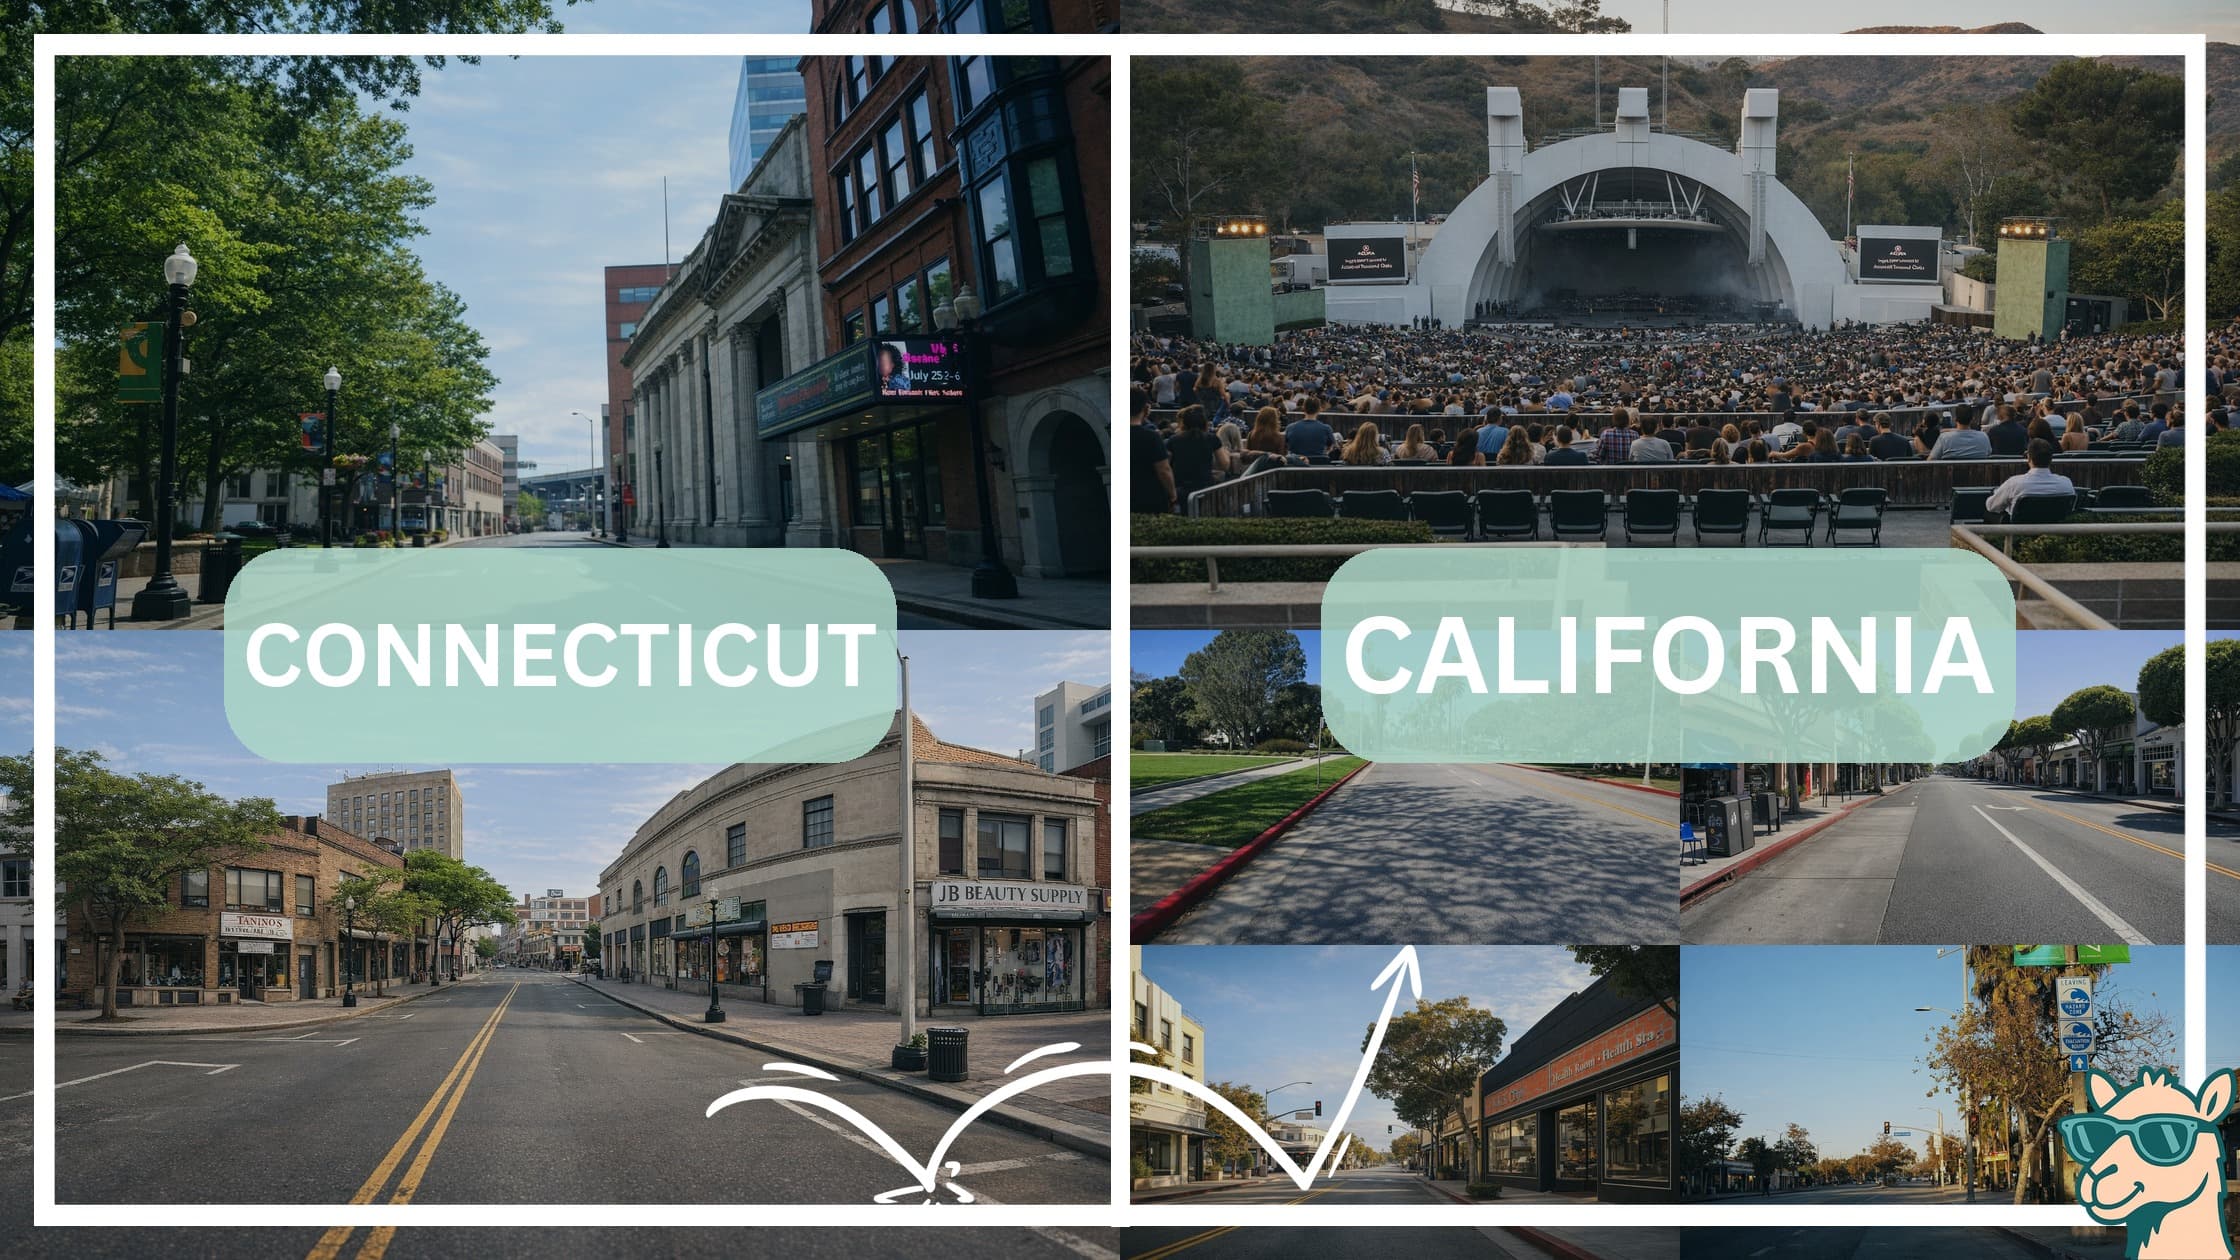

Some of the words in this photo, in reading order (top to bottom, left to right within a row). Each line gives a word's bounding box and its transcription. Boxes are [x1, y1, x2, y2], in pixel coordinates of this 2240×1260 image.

[911, 369, 929, 383] July
[939, 885, 960, 902] JB
[965, 886, 1028, 902] BEAUTY
[1031, 888, 1084, 905] SUPPLY
